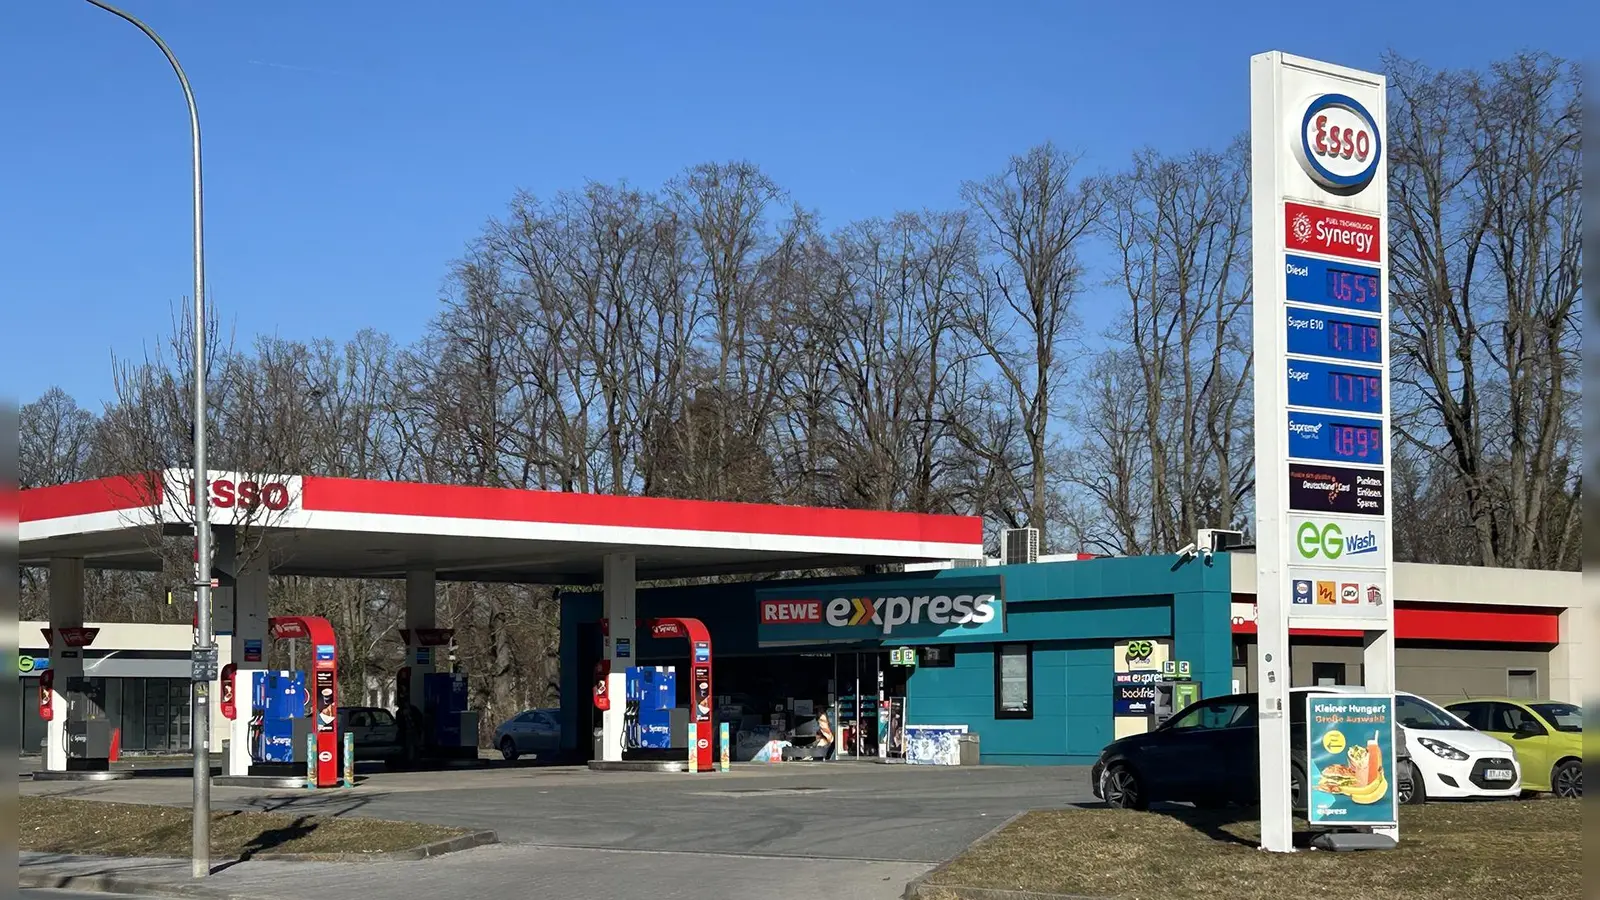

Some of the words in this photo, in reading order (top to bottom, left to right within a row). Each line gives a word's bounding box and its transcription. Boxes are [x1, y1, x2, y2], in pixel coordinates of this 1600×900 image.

[1316, 220, 1373, 253] Synergy
[1286, 263, 1309, 277] Diesel
[1287, 316, 1309, 330] Super
[1310, 319, 1324, 330] E10
[1288, 368, 1310, 382] Super
[1346, 530, 1375, 552] Wash
[764, 602, 820, 620] REWE
[826, 594, 995, 634] express
[1314, 704, 1347, 713] Kleiner
[1348, 704, 1386, 715] Hunger?
